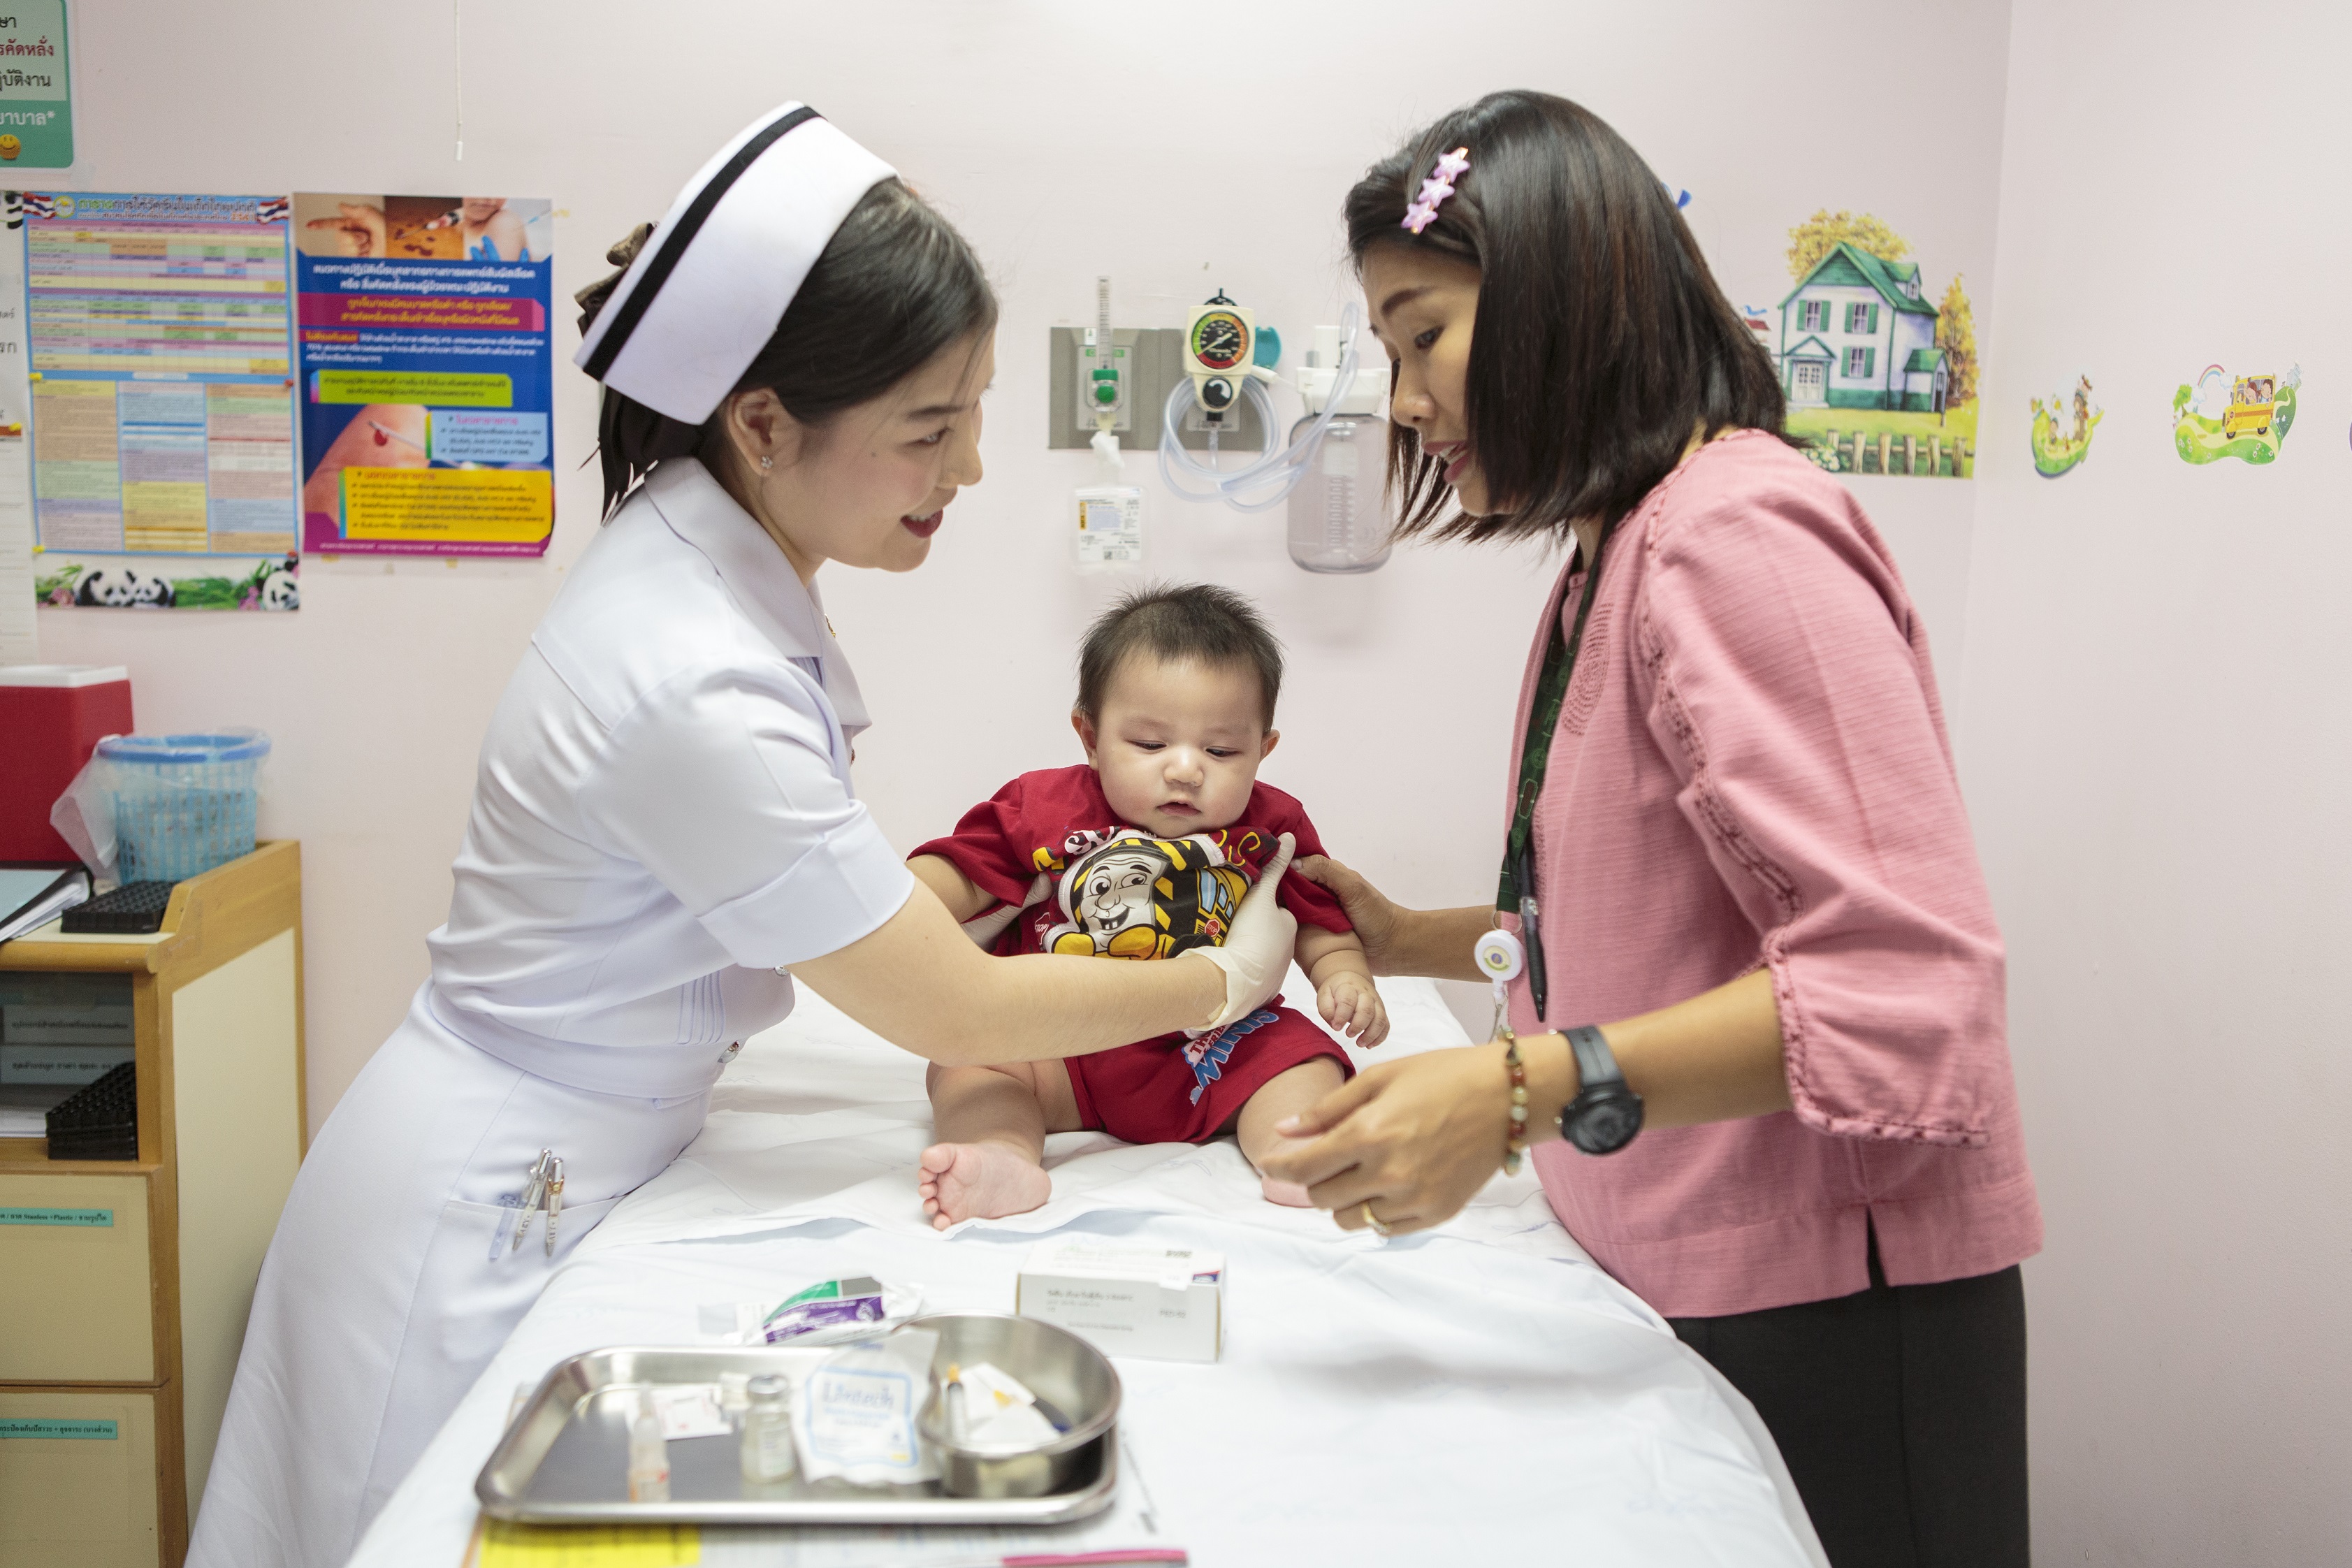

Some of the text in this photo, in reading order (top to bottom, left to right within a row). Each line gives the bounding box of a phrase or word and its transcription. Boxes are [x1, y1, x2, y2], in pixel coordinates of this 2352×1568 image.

[0, 69, 51, 91] บัติงาน
[1207, 923, 1218, 934] STOP
[1193, 1010, 1280, 1090] MINIS
